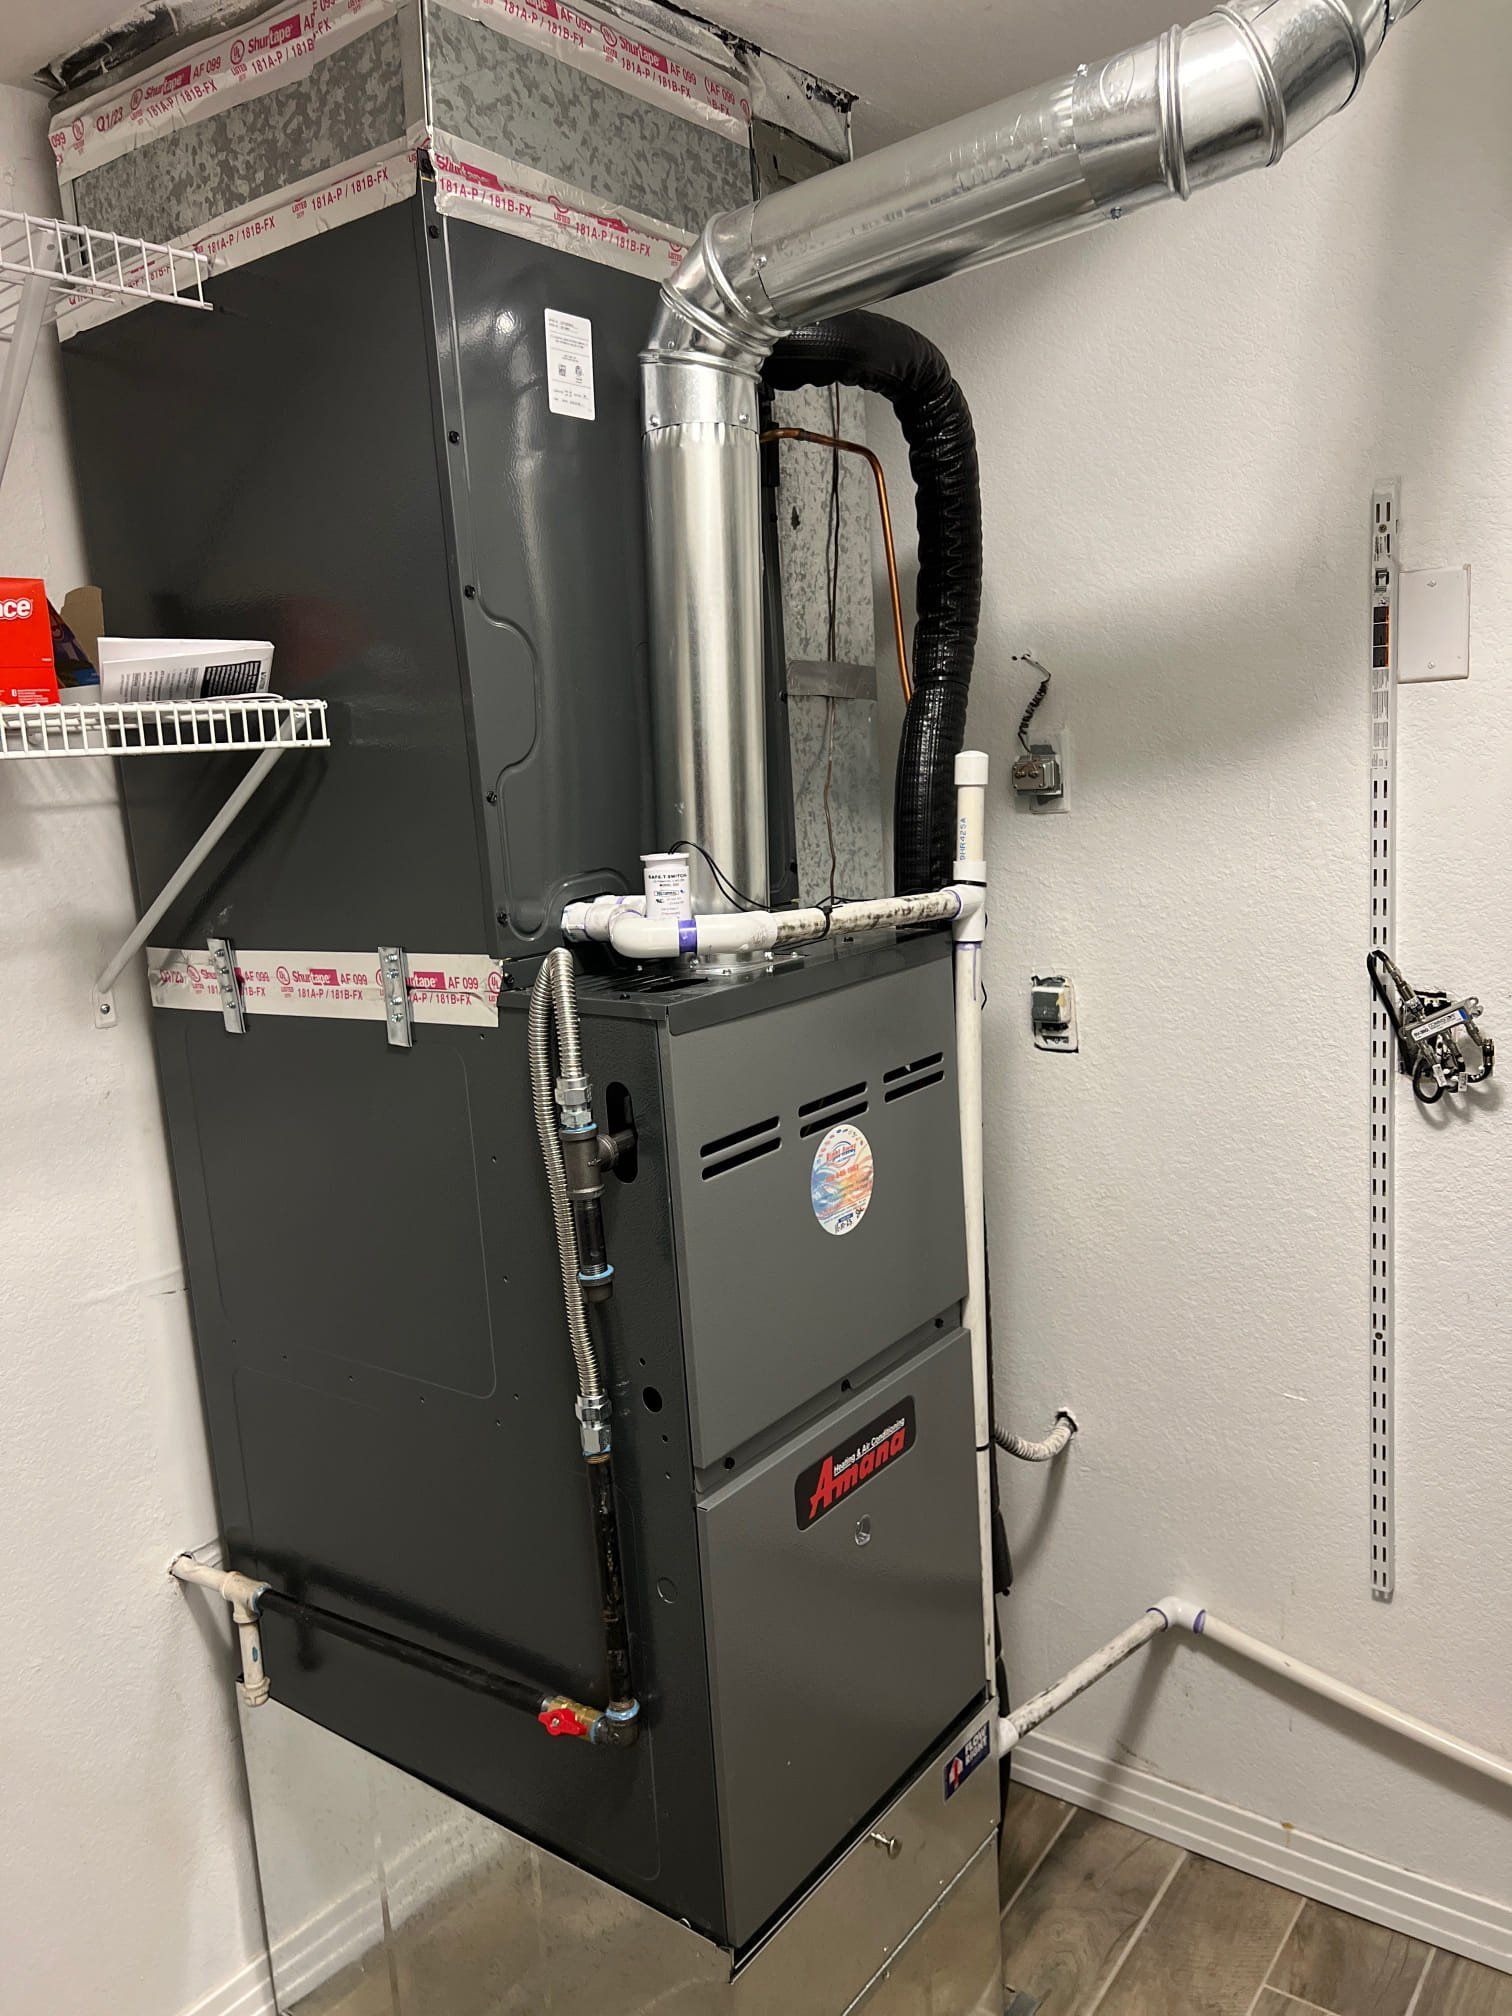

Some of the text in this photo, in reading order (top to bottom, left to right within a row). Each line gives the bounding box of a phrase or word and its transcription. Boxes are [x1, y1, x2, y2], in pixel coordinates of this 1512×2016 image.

[547, 20, 585, 48] 181B-FX
[205, 56, 221, 74] 099
[252, 52, 283, 74] 181A-P
[622, 58, 650, 79] 181A-P
[658, 73, 691, 99] 181B-FX
[146, 98, 175, 119] 181A-P
[180, 79, 218, 104] 181B-FX
[311, 187, 342, 211] 181A-P
[351, 167, 389, 194] 181B-FX
[440, 176, 478, 200] 181A-P
[490, 194, 532, 218] 181B-FX
[208, 233, 234, 255] 181A-P
[242, 215, 275, 240] 181B-FX
[575, 222, 608, 242] 181A-P
[616, 235, 651, 257] 181B-FX
[298, 988, 324, 999] 181A-P
[331, 989, 363, 1001] 181B-FX
[340, 974, 351, 984] AF
[352, 974, 368, 986] 099
[448, 977, 460, 989] AF
[462, 977, 479, 990] 099
[436, 993, 471, 1005] 181B-FX
[809, 1428, 905, 1519] Amana
